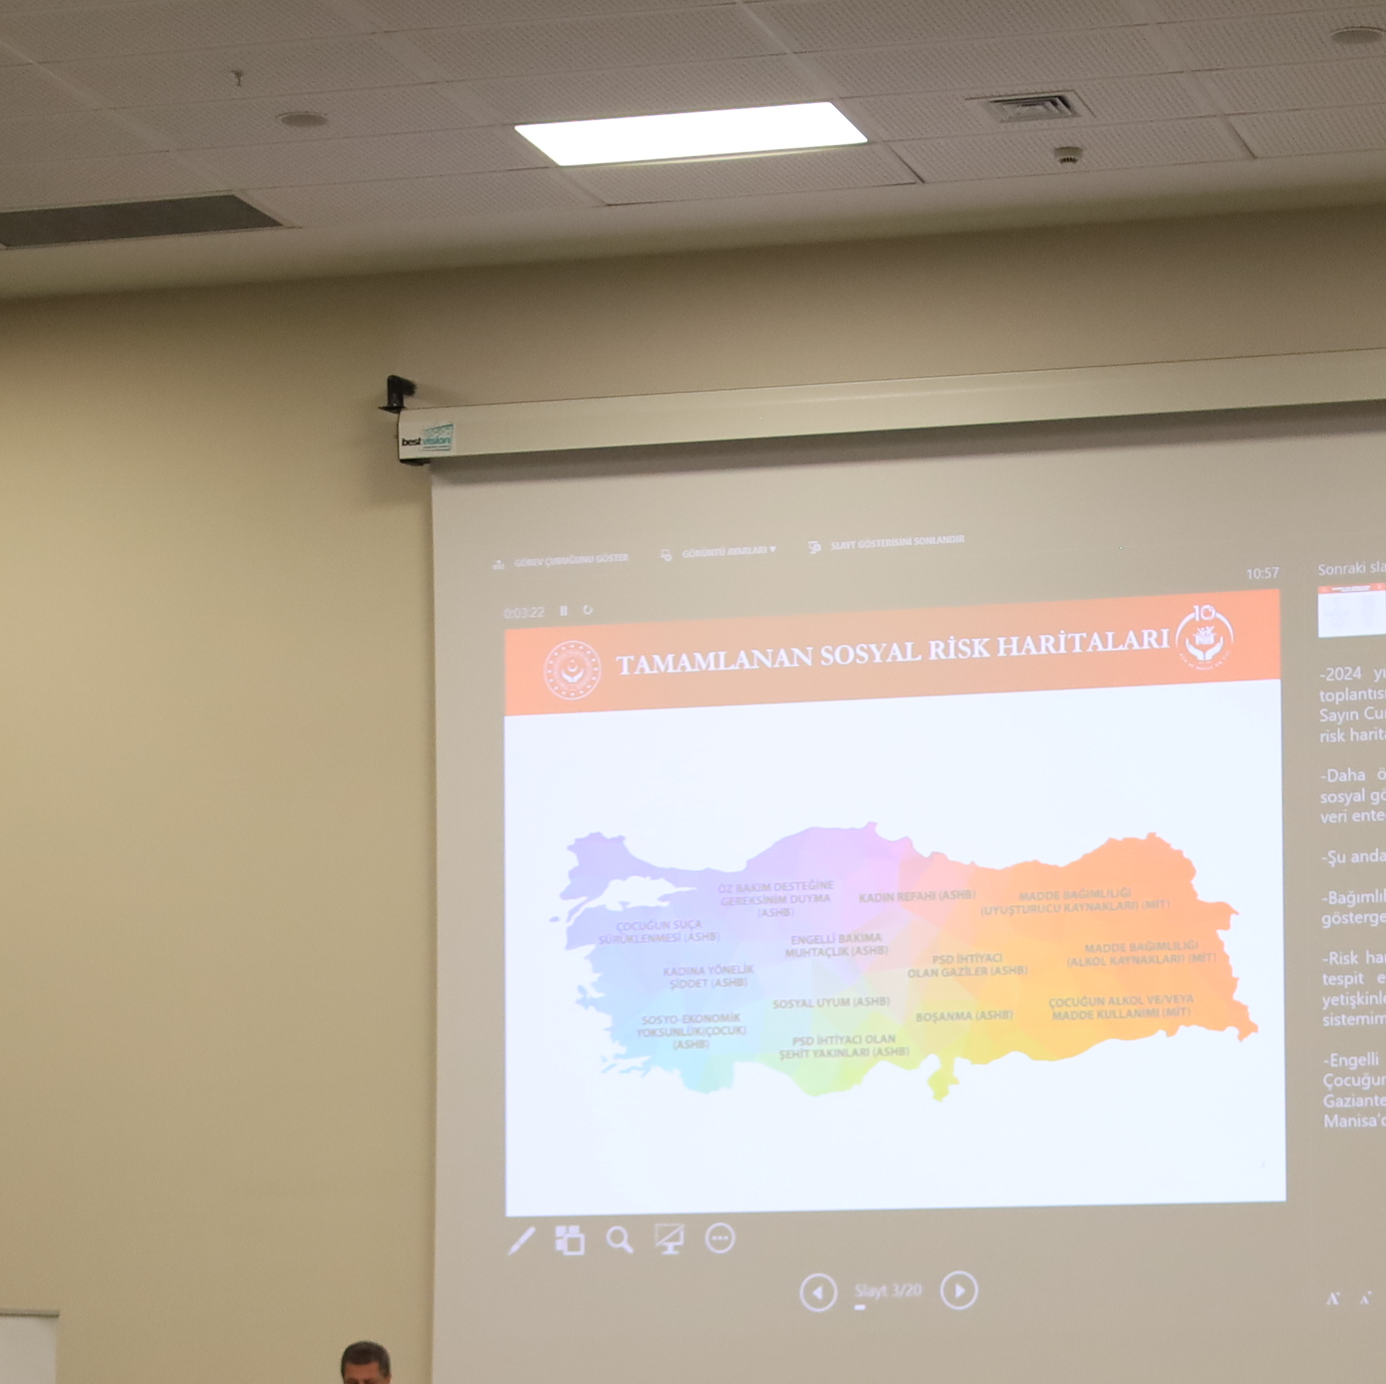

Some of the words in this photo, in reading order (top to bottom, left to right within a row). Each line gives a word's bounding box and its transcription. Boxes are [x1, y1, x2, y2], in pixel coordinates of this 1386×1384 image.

[402, 437, 421, 446] best
[1246, 567, 1280, 580] 10:57
[1318, 561, 1366, 576] Sonraki
[615, 644, 814, 677] TAMAMLANAN
[820, 640, 921, 667] SOSYAL
[928, 633, 990, 661] RİSK
[996, 626, 1170, 657] HARİTALARI
[1319, 665, 1362, 681] -2024
[1319, 708, 1359, 724] Sayın
[1320, 727, 1346, 742] risk
[1320, 767, 1366, 782] -Daha
[1320, 787, 1365, 805] sosyal
[1320, 809, 1347, 823] veri
[1321, 849, 1346, 867] -Şu
[1323, 1051, 1380, 1070] -Engelli
[855, 1283, 887, 1301] Slayt
[892, 1283, 922, 1297] 3/20
